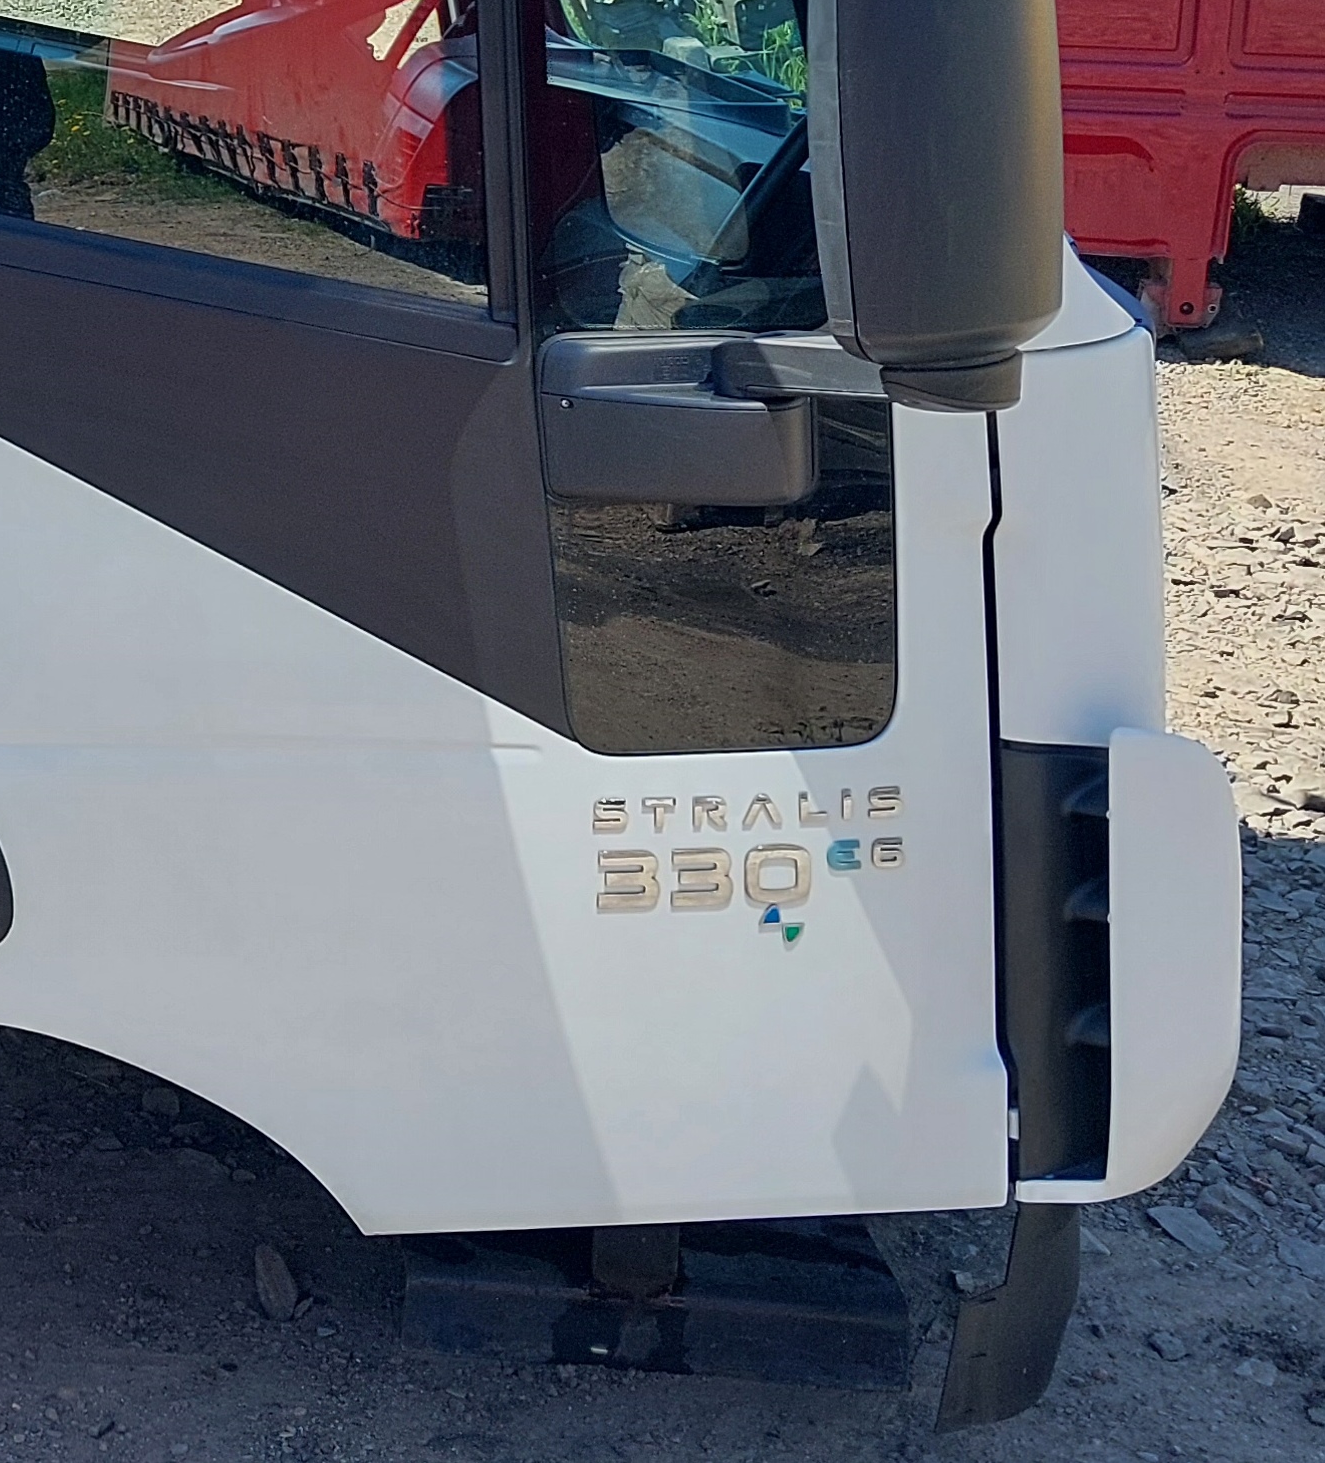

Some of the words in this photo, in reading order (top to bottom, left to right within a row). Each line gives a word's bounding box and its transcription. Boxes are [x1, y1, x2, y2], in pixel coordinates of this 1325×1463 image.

[592, 785, 903, 833] STRALIS
[597, 843, 812, 912] 330
[826, 837, 904, 870] E6
